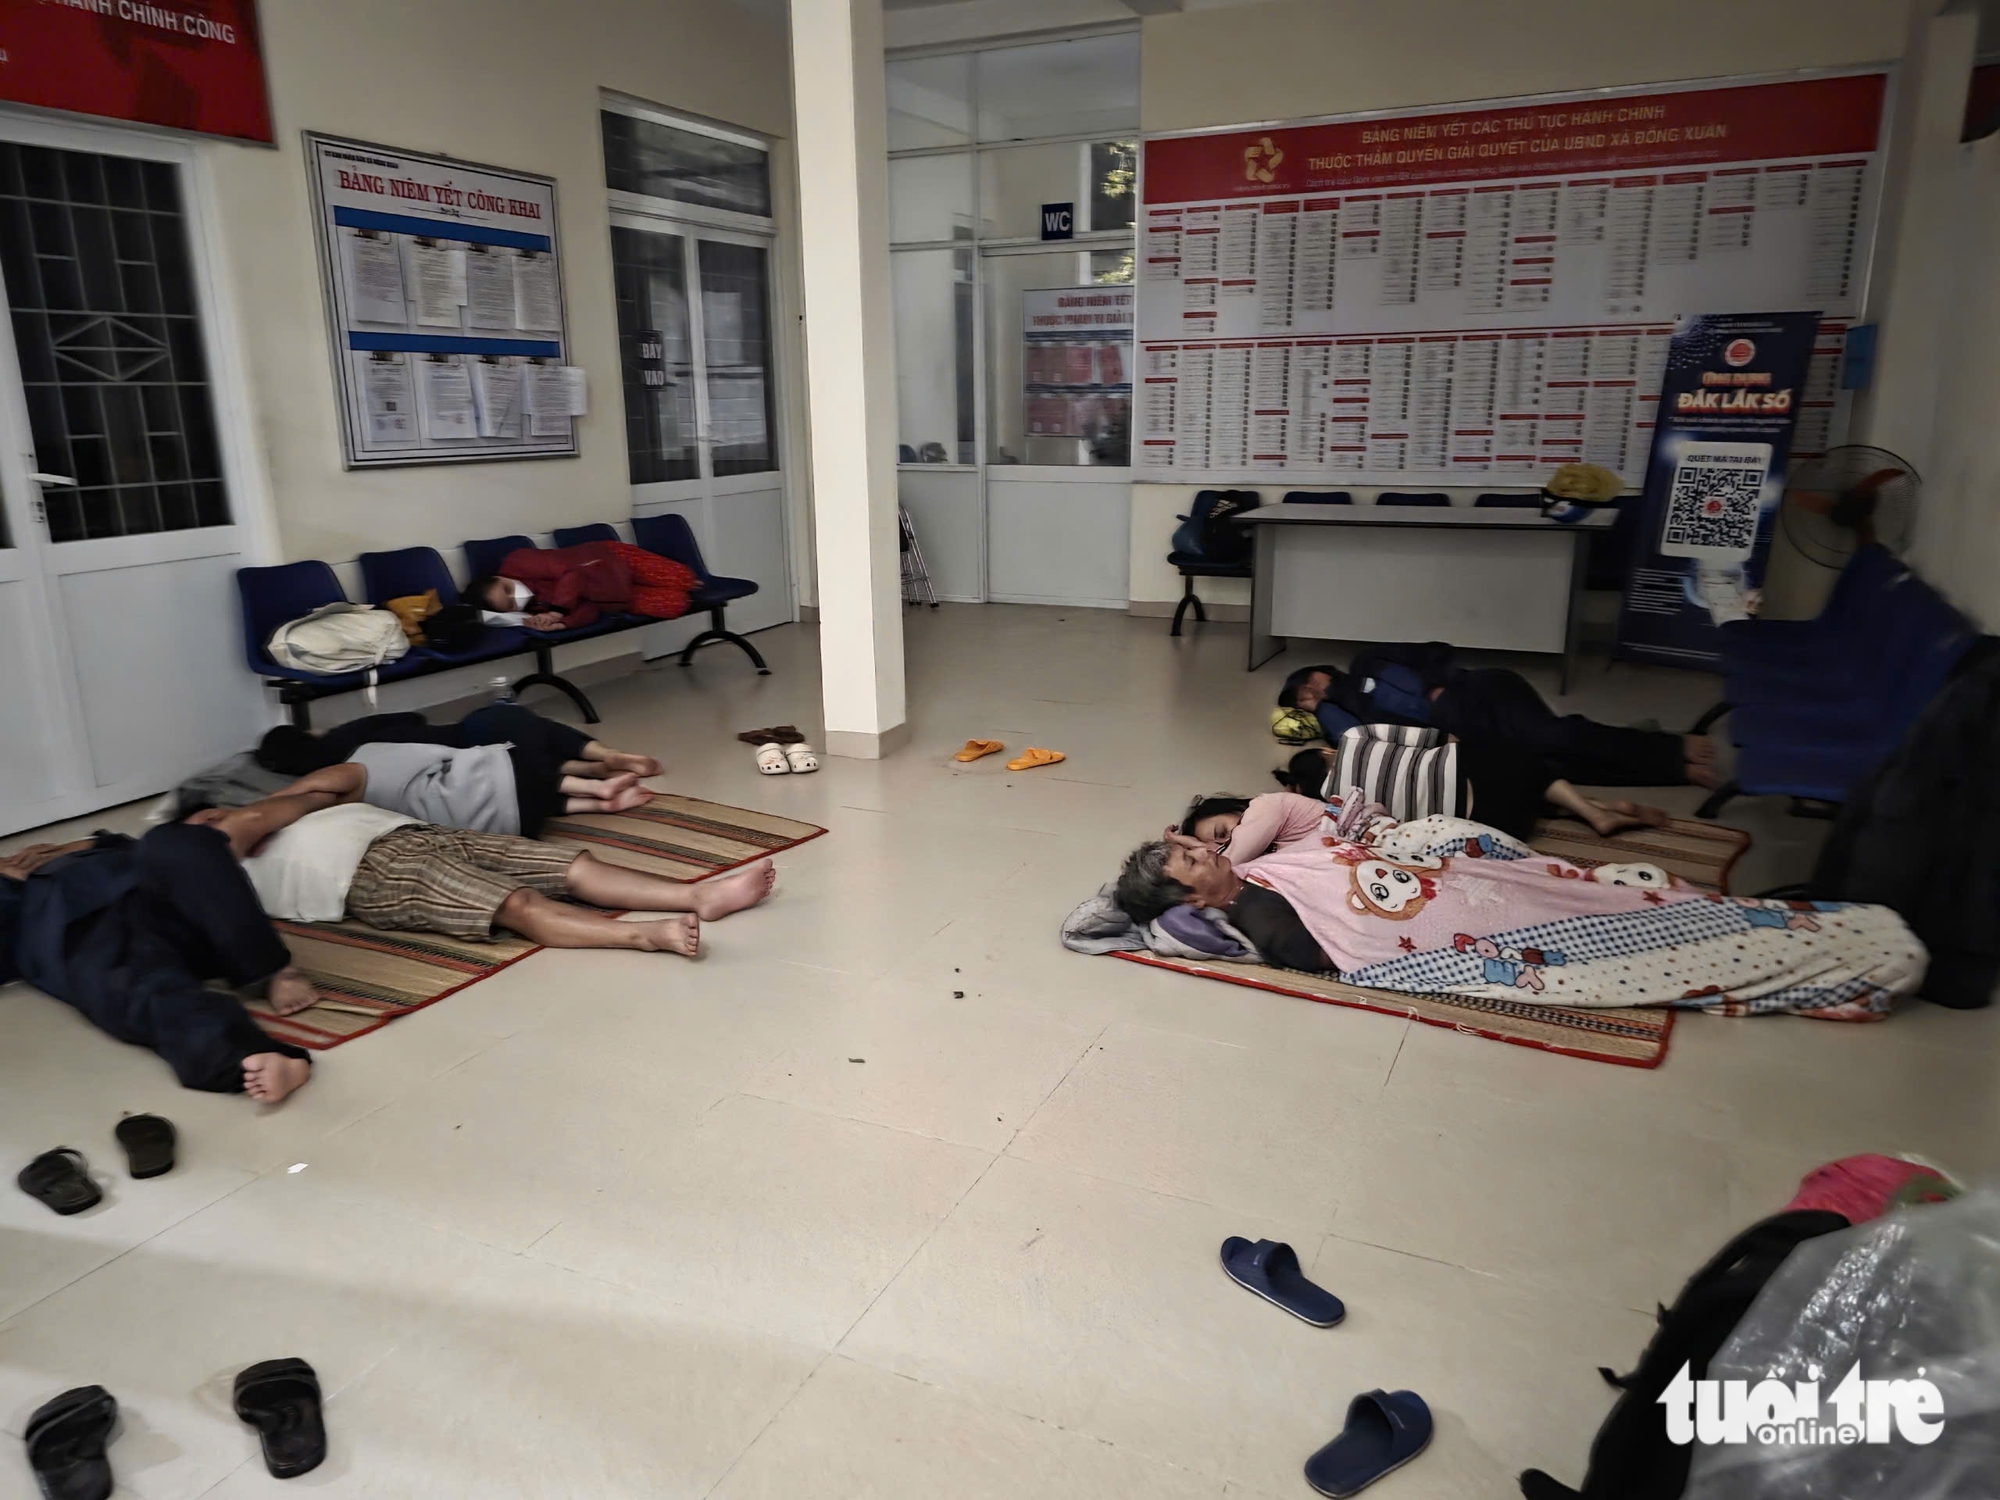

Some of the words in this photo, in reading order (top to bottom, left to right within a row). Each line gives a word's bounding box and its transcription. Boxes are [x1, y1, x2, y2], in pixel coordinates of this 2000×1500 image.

[118, 0, 179, 31] CHÍNH
[183, 13, 236, 44] CÔNG
[1564, 134, 1606, 151] UBND
[338, 165, 385, 196] BẢNG
[389, 177, 430, 202] NIÊM
[433, 180, 463, 207] YẾT
[467, 189, 505, 215] CÔNG
[508, 198, 542, 220] KHAI
[1045, 211, 1071, 232] WC
